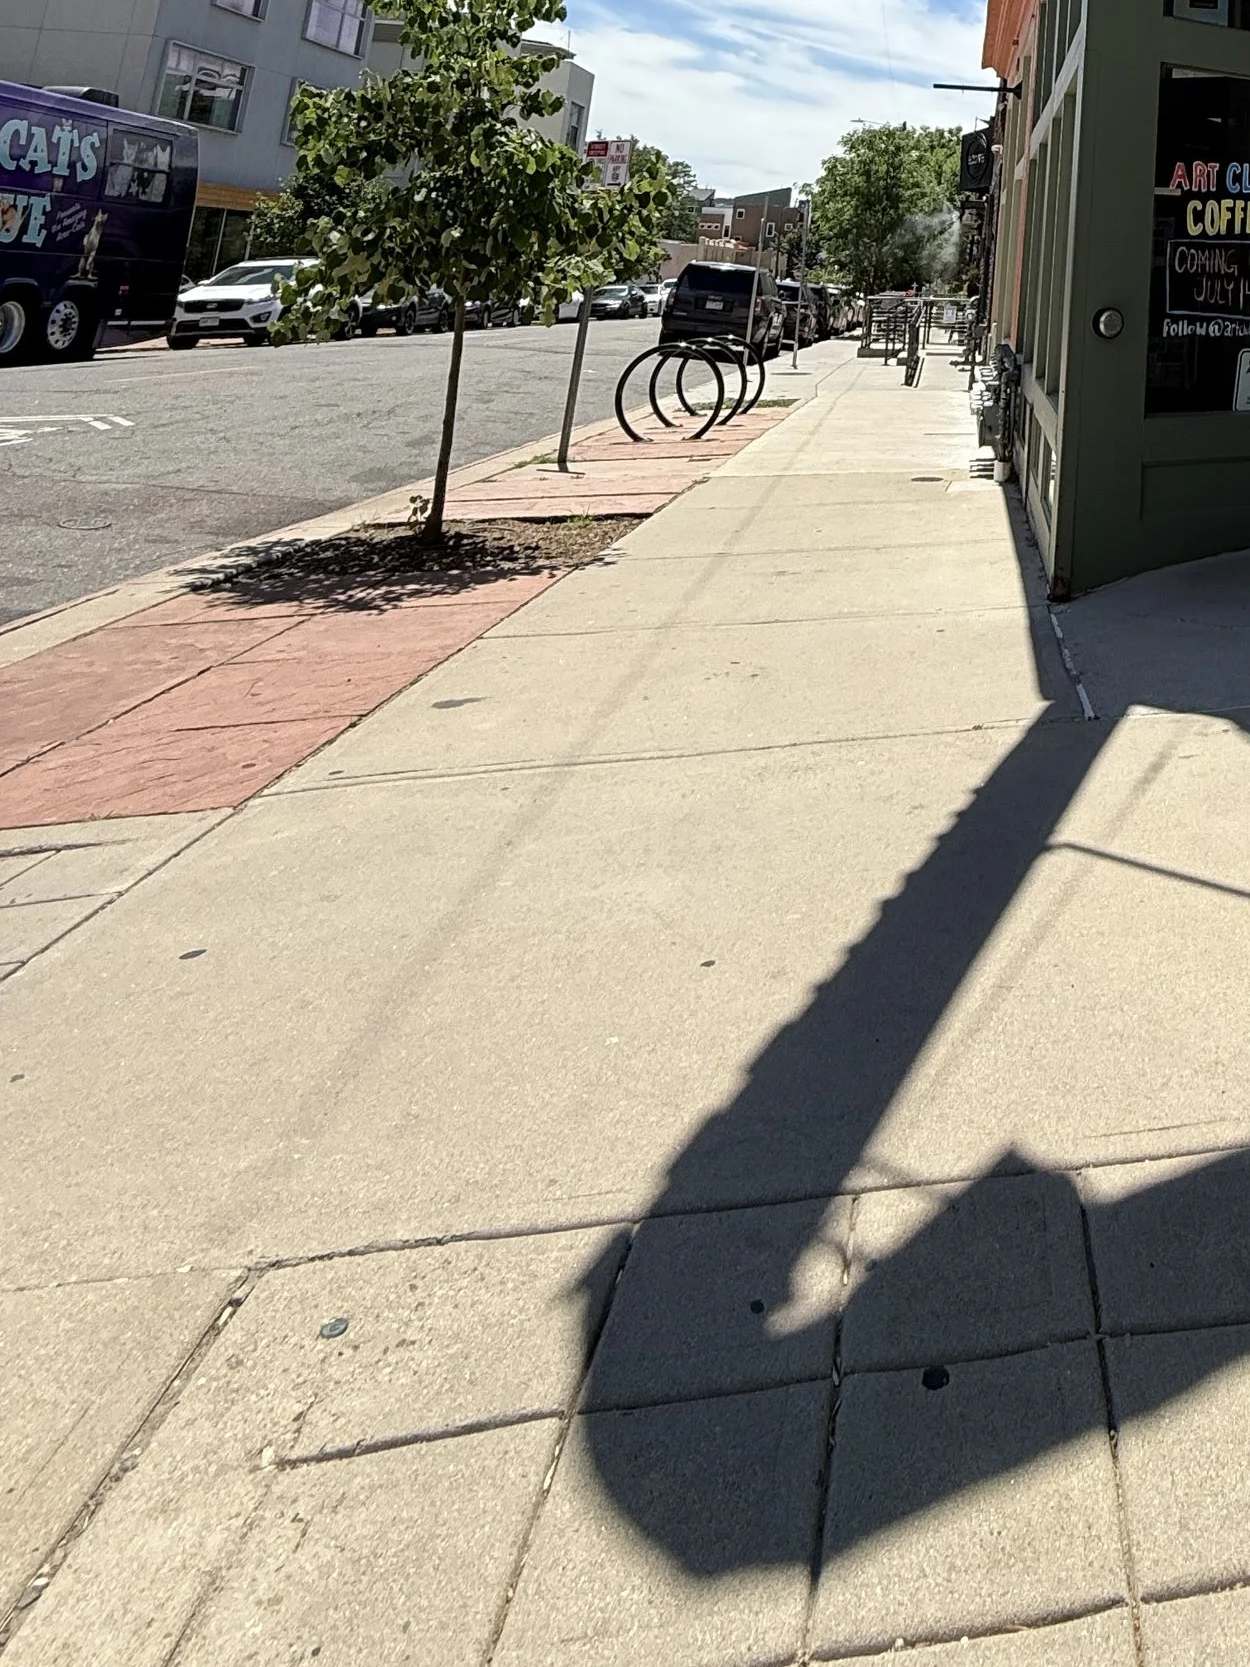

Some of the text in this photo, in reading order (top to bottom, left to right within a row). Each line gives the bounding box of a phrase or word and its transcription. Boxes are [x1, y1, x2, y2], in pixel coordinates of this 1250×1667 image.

[0, 118, 100, 183] CATS
[1169, 160, 1220, 193] ART
[1174, 246, 1238, 276] COMING
[1193, 275, 1234, 306] JULY
[1162, 318, 1207, 338] Follow
